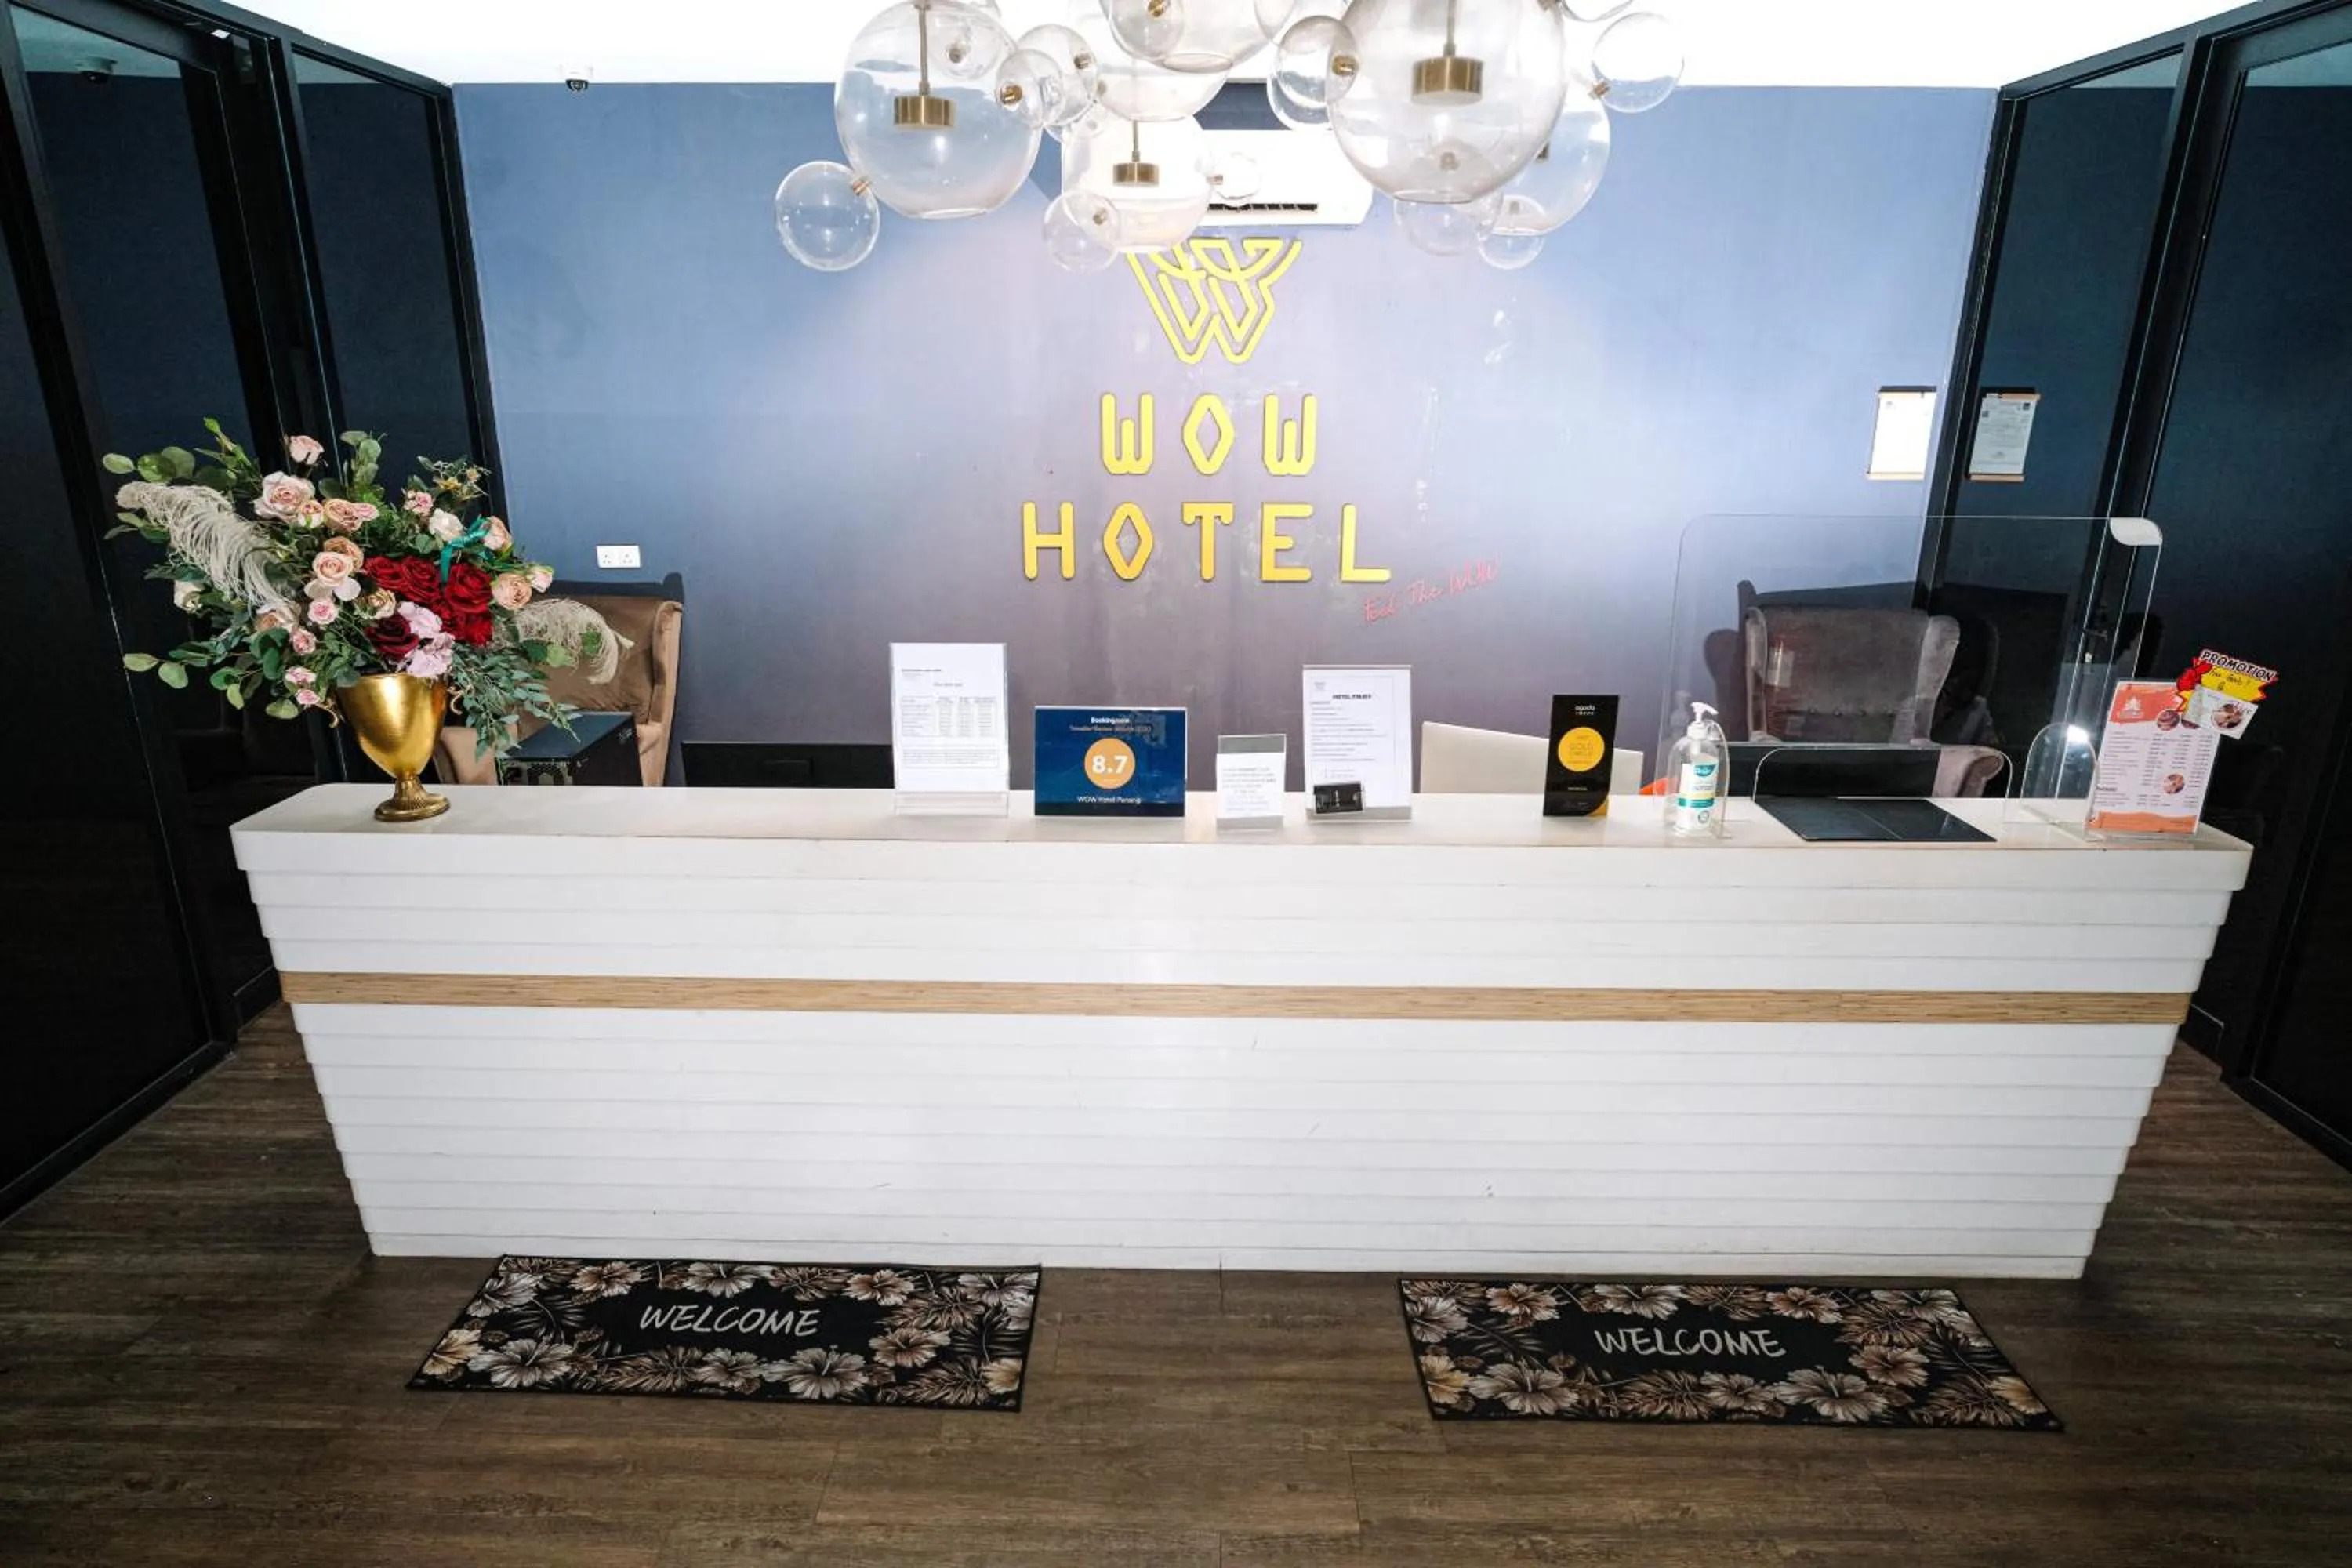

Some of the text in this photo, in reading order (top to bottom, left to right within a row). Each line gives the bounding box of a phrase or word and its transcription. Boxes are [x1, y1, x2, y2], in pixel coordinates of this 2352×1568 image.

[1102, 394, 1316, 475] WOW
[1022, 502, 1392, 582] HOTEL
[2200, 649, 2276, 681] PROMOTION
[1091, 755, 1128, 774] 8.7
[640, 1305, 821, 1337] WELCOME
[1594, 1327, 1787, 1357] WELCOME
